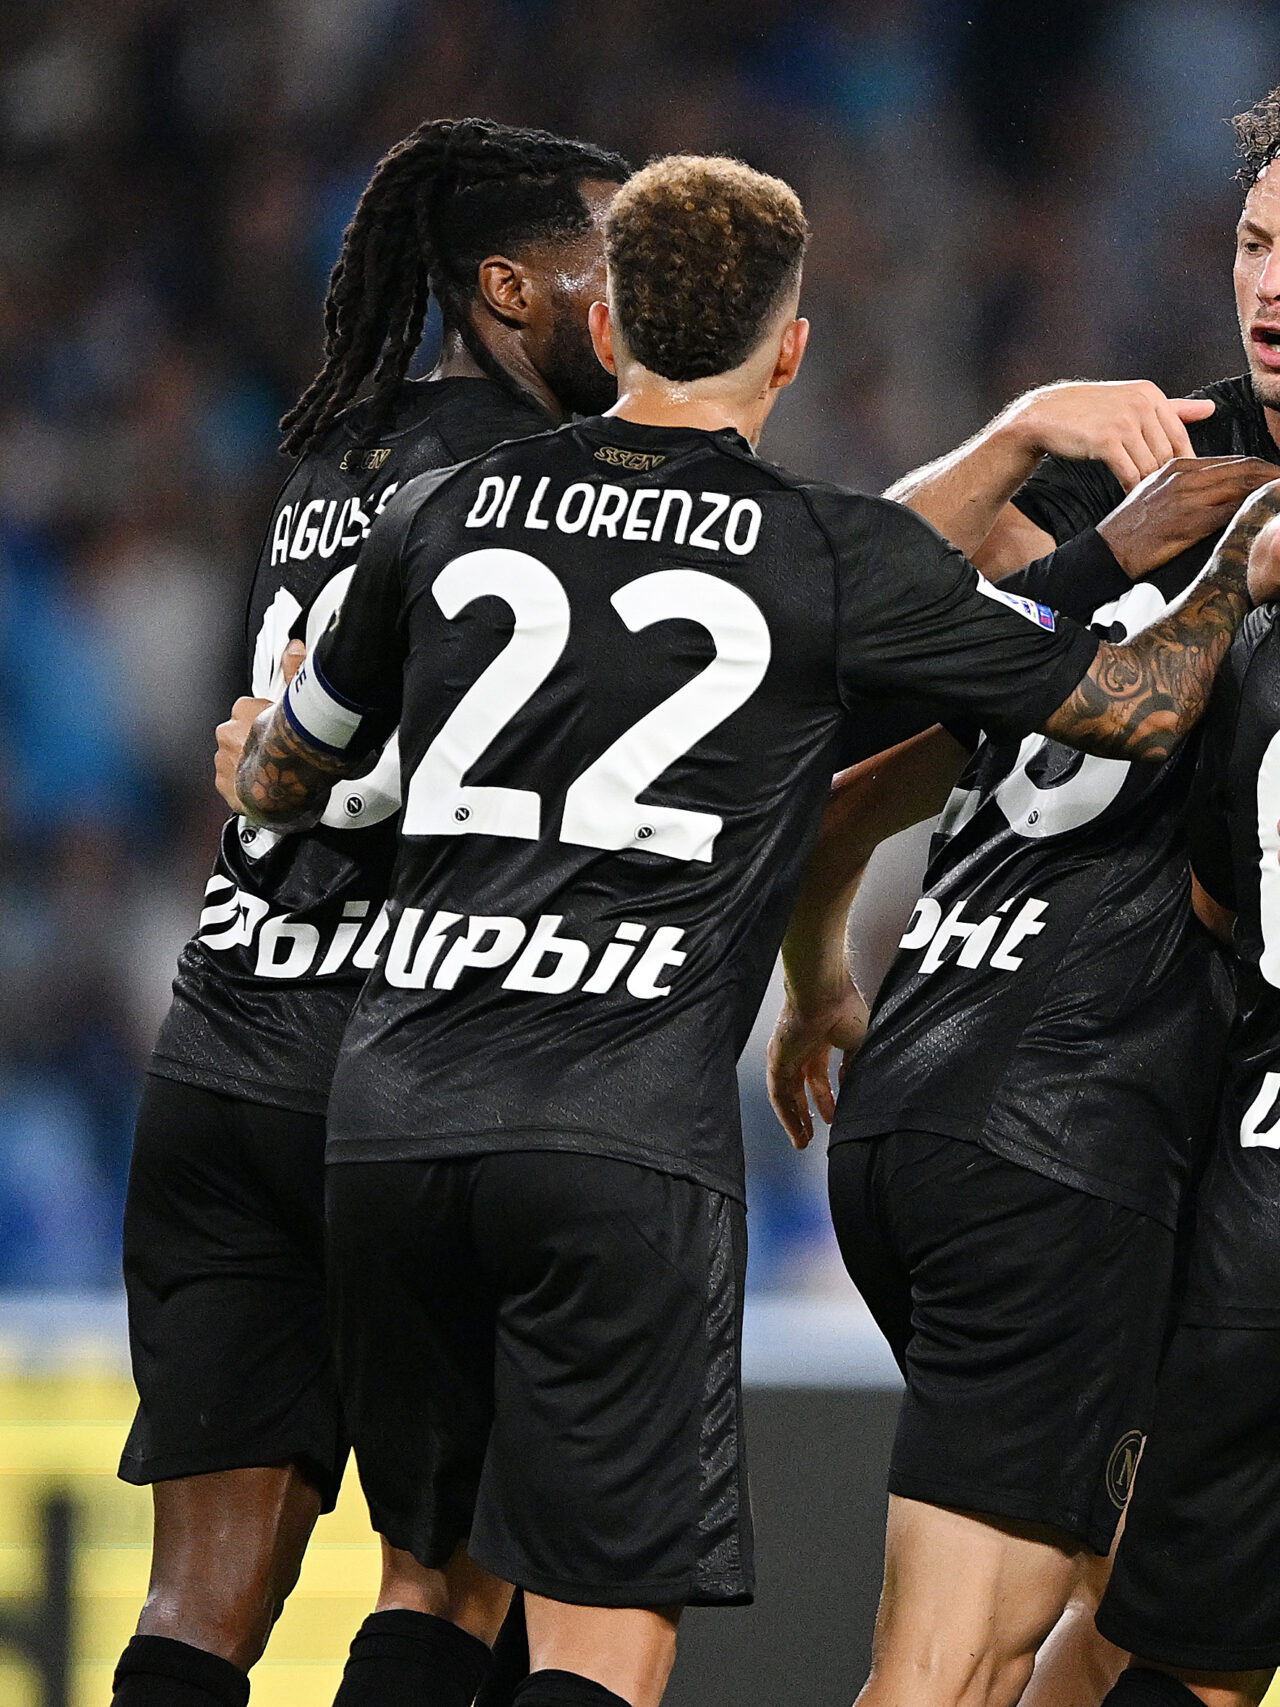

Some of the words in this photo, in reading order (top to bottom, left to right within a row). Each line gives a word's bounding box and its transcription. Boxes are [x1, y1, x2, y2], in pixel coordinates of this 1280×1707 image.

[339, 448, 392, 471] SCN
[594, 446, 666, 471] SSCN
[465, 475, 522, 529] DI
[524, 476, 763, 556] LORENZO
[402, 548, 772, 863] 22
